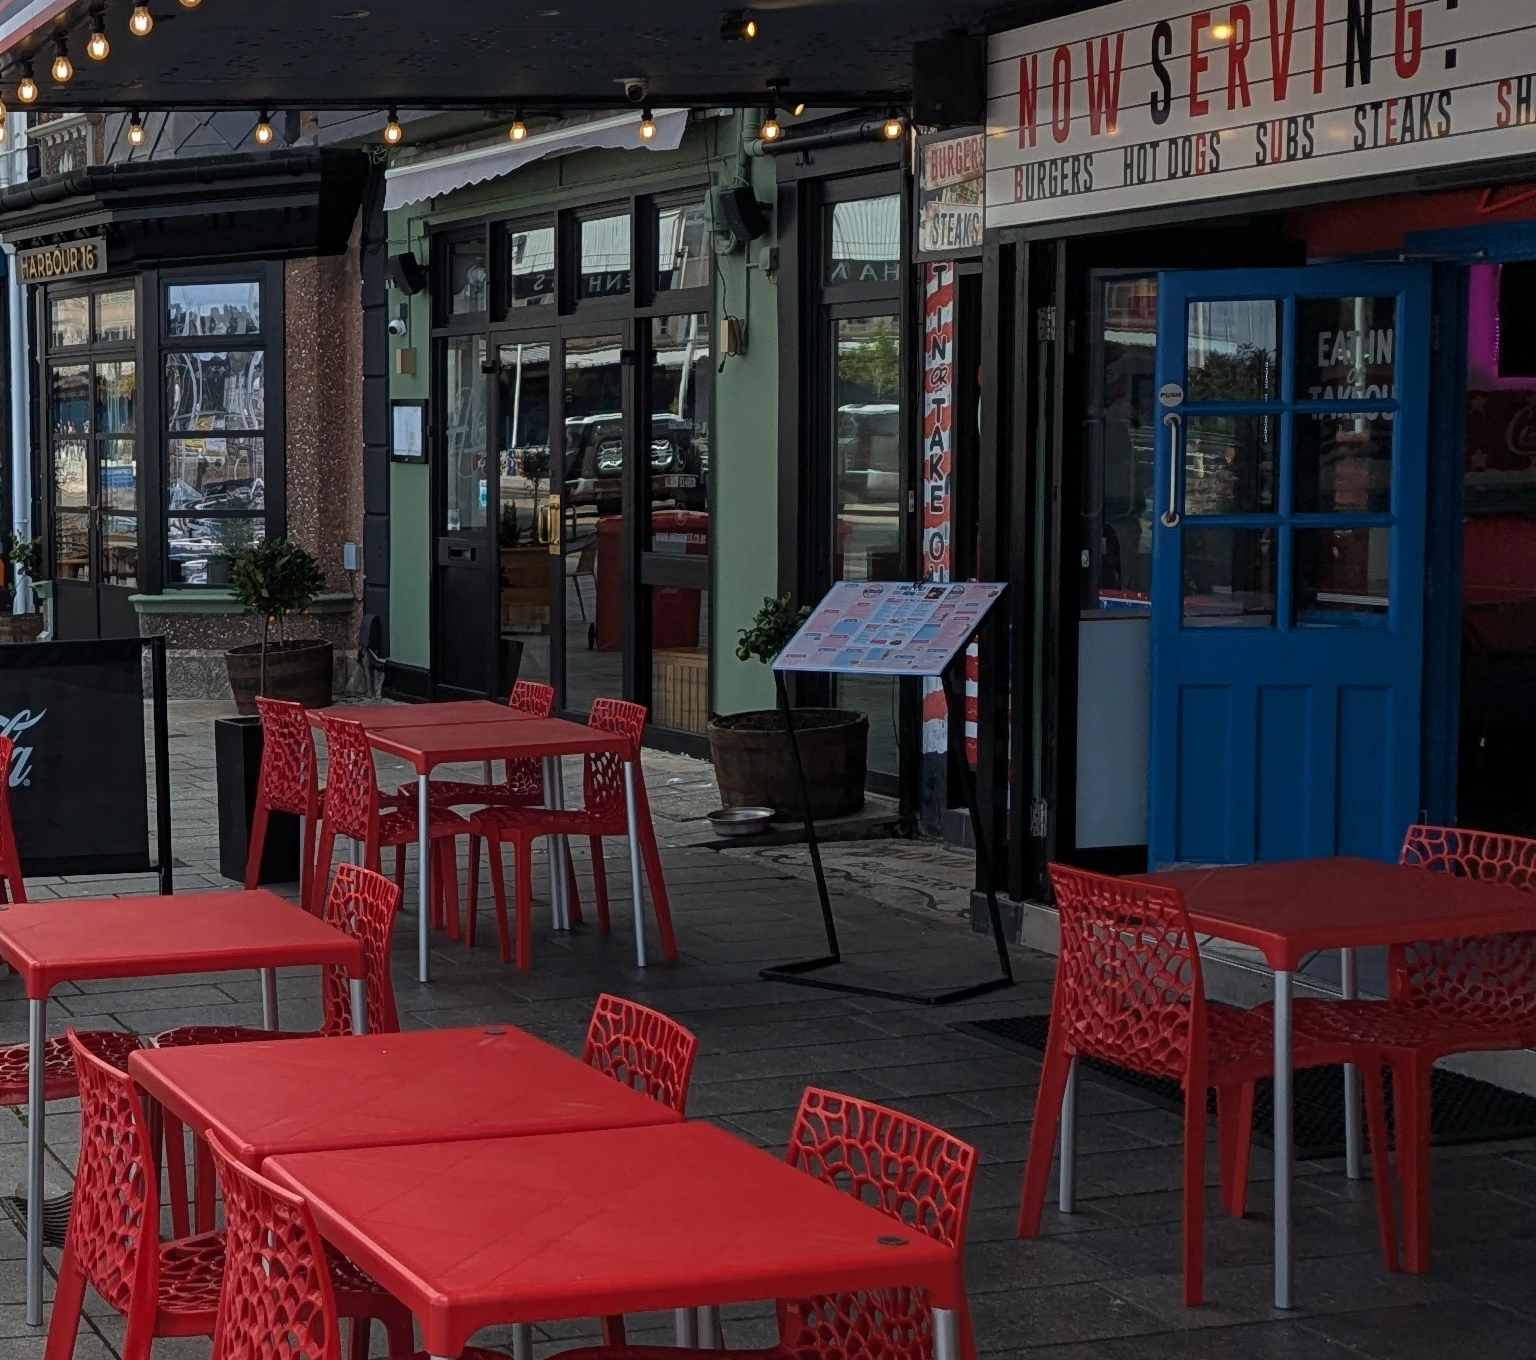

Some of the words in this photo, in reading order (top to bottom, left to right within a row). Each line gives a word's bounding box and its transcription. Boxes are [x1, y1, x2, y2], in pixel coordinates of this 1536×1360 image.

[1018, 32, 1125, 149] NOW
[1013, 153, 1094, 202] BURGERS
[1124, 141, 1159, 185] HOT
[1167, 130, 1221, 180] DOGS
[1255, 114, 1315, 166] SUBS
[1353, 88, 1452, 149] STEAKS
[1496, 74, 1536, 129] SH
[21, 247, 78, 279] HARBOUR
[81, 245, 94, 270] 16
[932, 213, 980, 246] STEAKS
[1368, 328, 1393, 365] IN
[929, 397, 946, 513] TAKE
